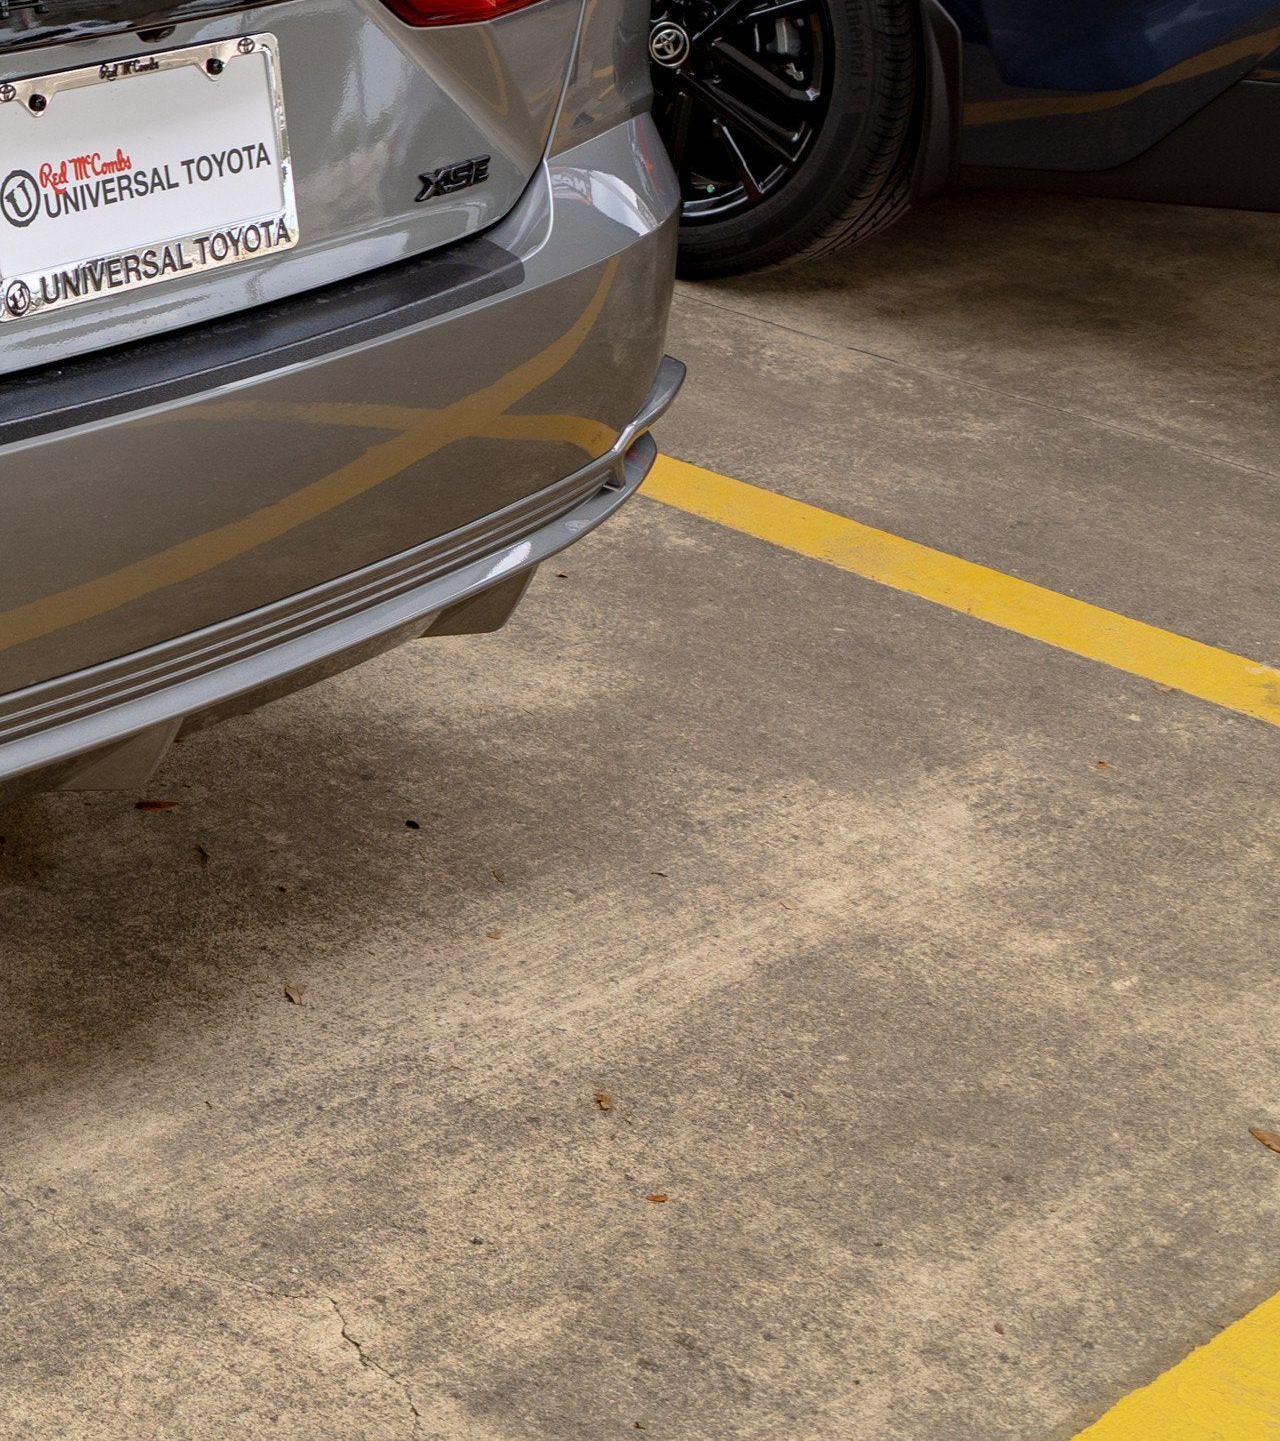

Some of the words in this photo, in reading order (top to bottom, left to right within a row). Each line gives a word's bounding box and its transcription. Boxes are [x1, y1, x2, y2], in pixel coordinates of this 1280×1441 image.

[39, 161, 69, 195] Red
[67, 148, 132, 181] McCombs
[43, 165, 180, 219] UNIVERSAL
[180, 143, 271, 185] TOYOTA
[414, 154, 491, 203] XSE
[40, 243, 192, 304] UNIVERSAL
[194, 218, 291, 261] TOYOTA
